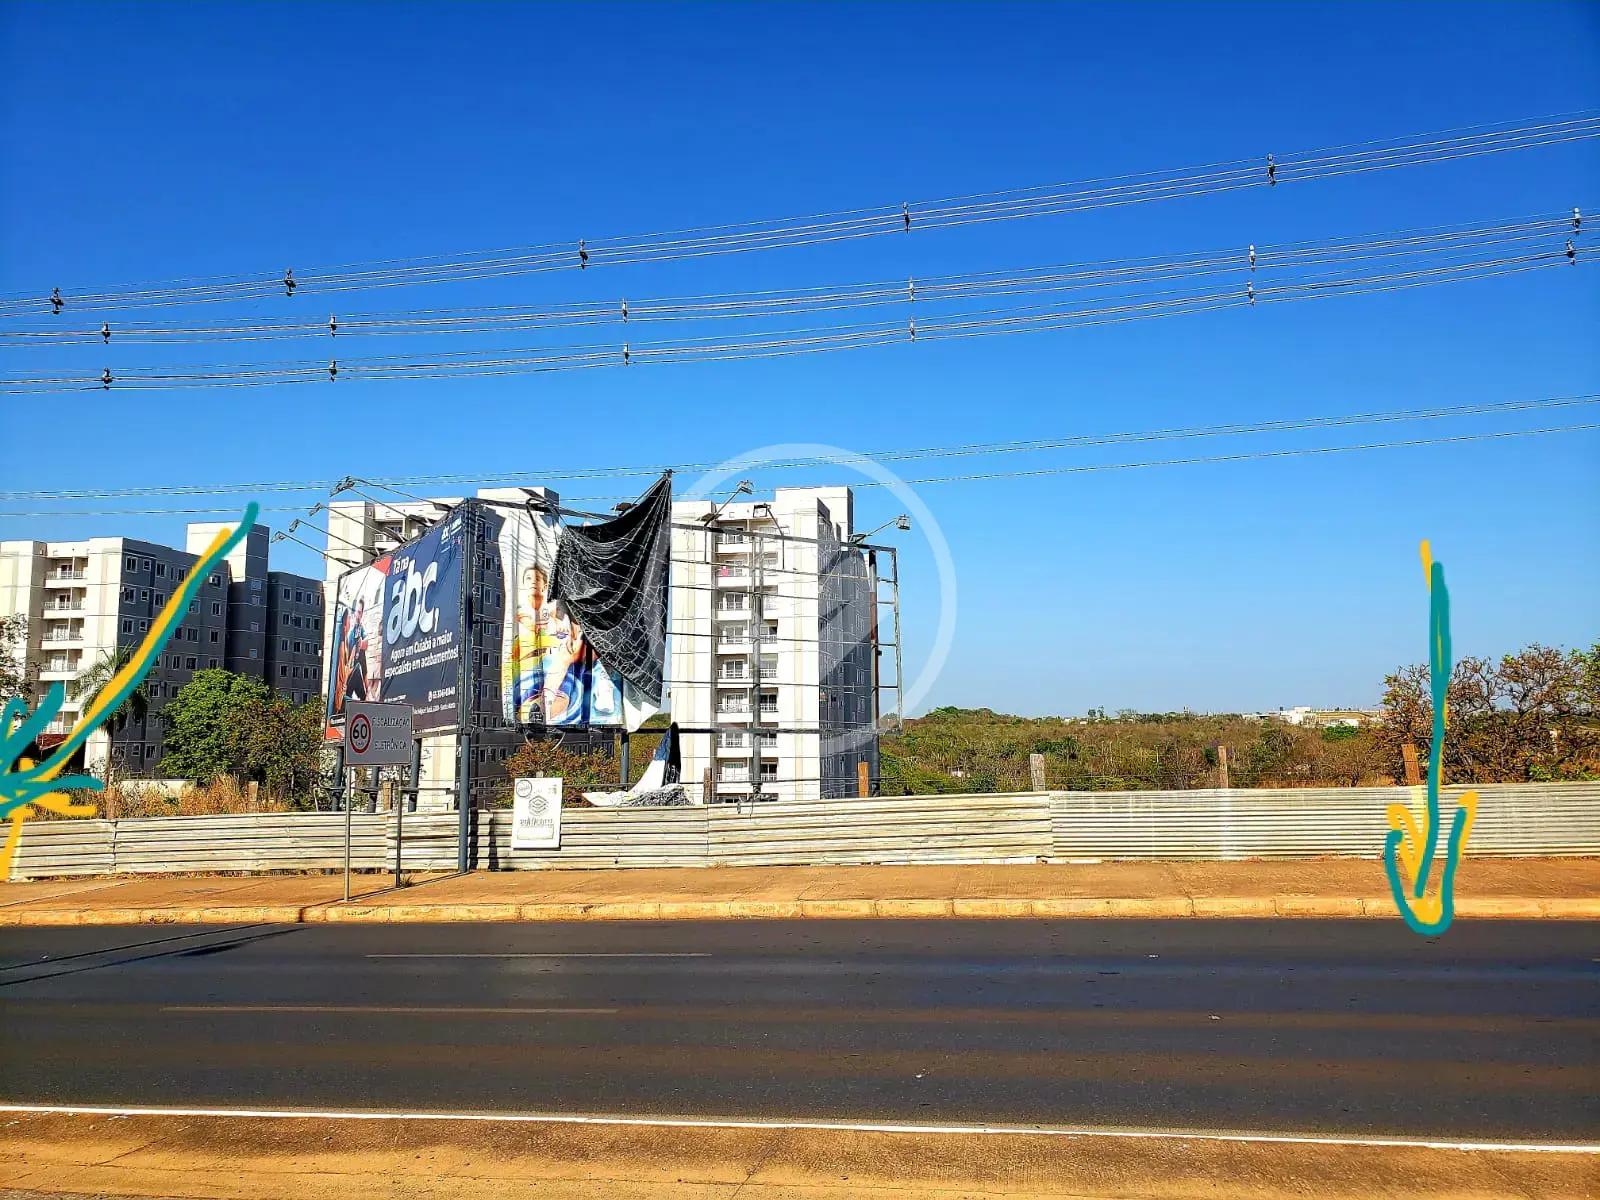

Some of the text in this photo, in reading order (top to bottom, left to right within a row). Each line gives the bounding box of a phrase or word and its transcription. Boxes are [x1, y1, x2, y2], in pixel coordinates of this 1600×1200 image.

[405, 645, 414, 657] em
[414, 635, 432, 654] Cuiabá
[437, 629, 453, 645] maior
[384, 644, 459, 680] especialista em acabamentos!
[353, 723, 368, 740] 60
[374, 737, 407, 750] ELETRÔNICA
